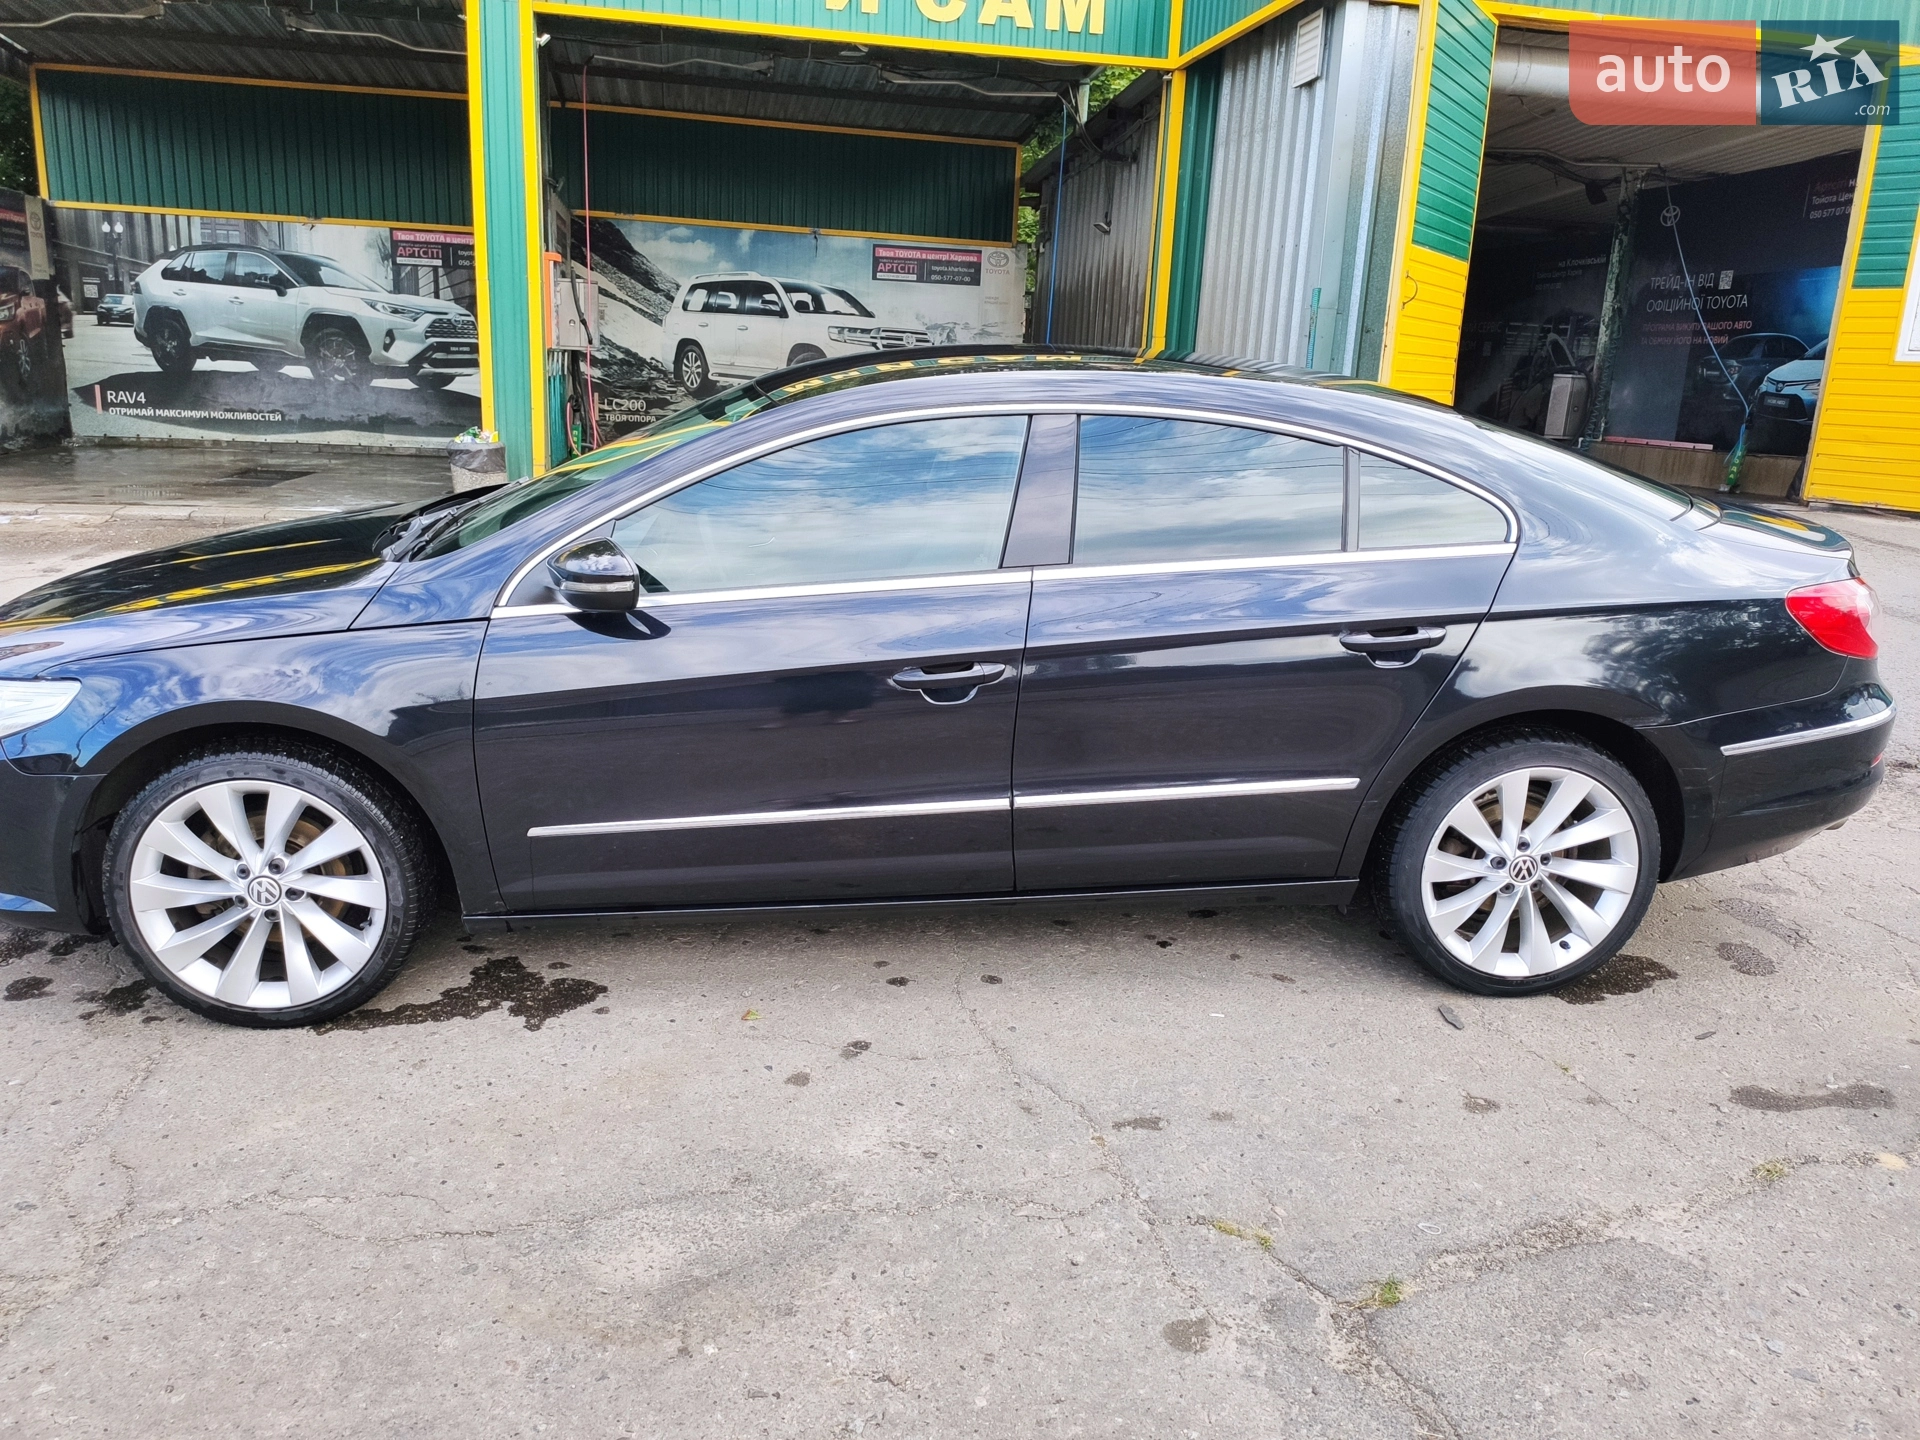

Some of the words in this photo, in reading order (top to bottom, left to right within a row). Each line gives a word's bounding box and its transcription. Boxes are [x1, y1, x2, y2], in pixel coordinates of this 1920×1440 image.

[397, 232, 414, 240] Твоя
[415, 233, 445, 242] TOYOTA
[879, 249, 894, 257] Твоя
[895, 250, 921, 259] TOYOTA
[927, 252, 949, 261] центрі
[950, 254, 978, 263] Харкова
[930, 274, 971, 283] 050-577-07-00
[1698, 273, 1715, 289] ВІД
[1647, 294, 1706, 313] ОФІЦІЙНОЇ
[1706, 294, 1748, 310] TOYOTA
[1733, 320, 1752, 329] АВТО
[107, 390, 147, 404] RAV4
[605, 398, 646, 411] LC200
[109, 406, 154, 416] ОТРИМАЙ
[155, 408, 209, 418] МАКСИМУМ
[210, 410, 282, 421] МОЖЛИВОСТЕЙ
[605, 413, 627, 421] ТВОЯ
[628, 414, 657, 423] ОПОРА
